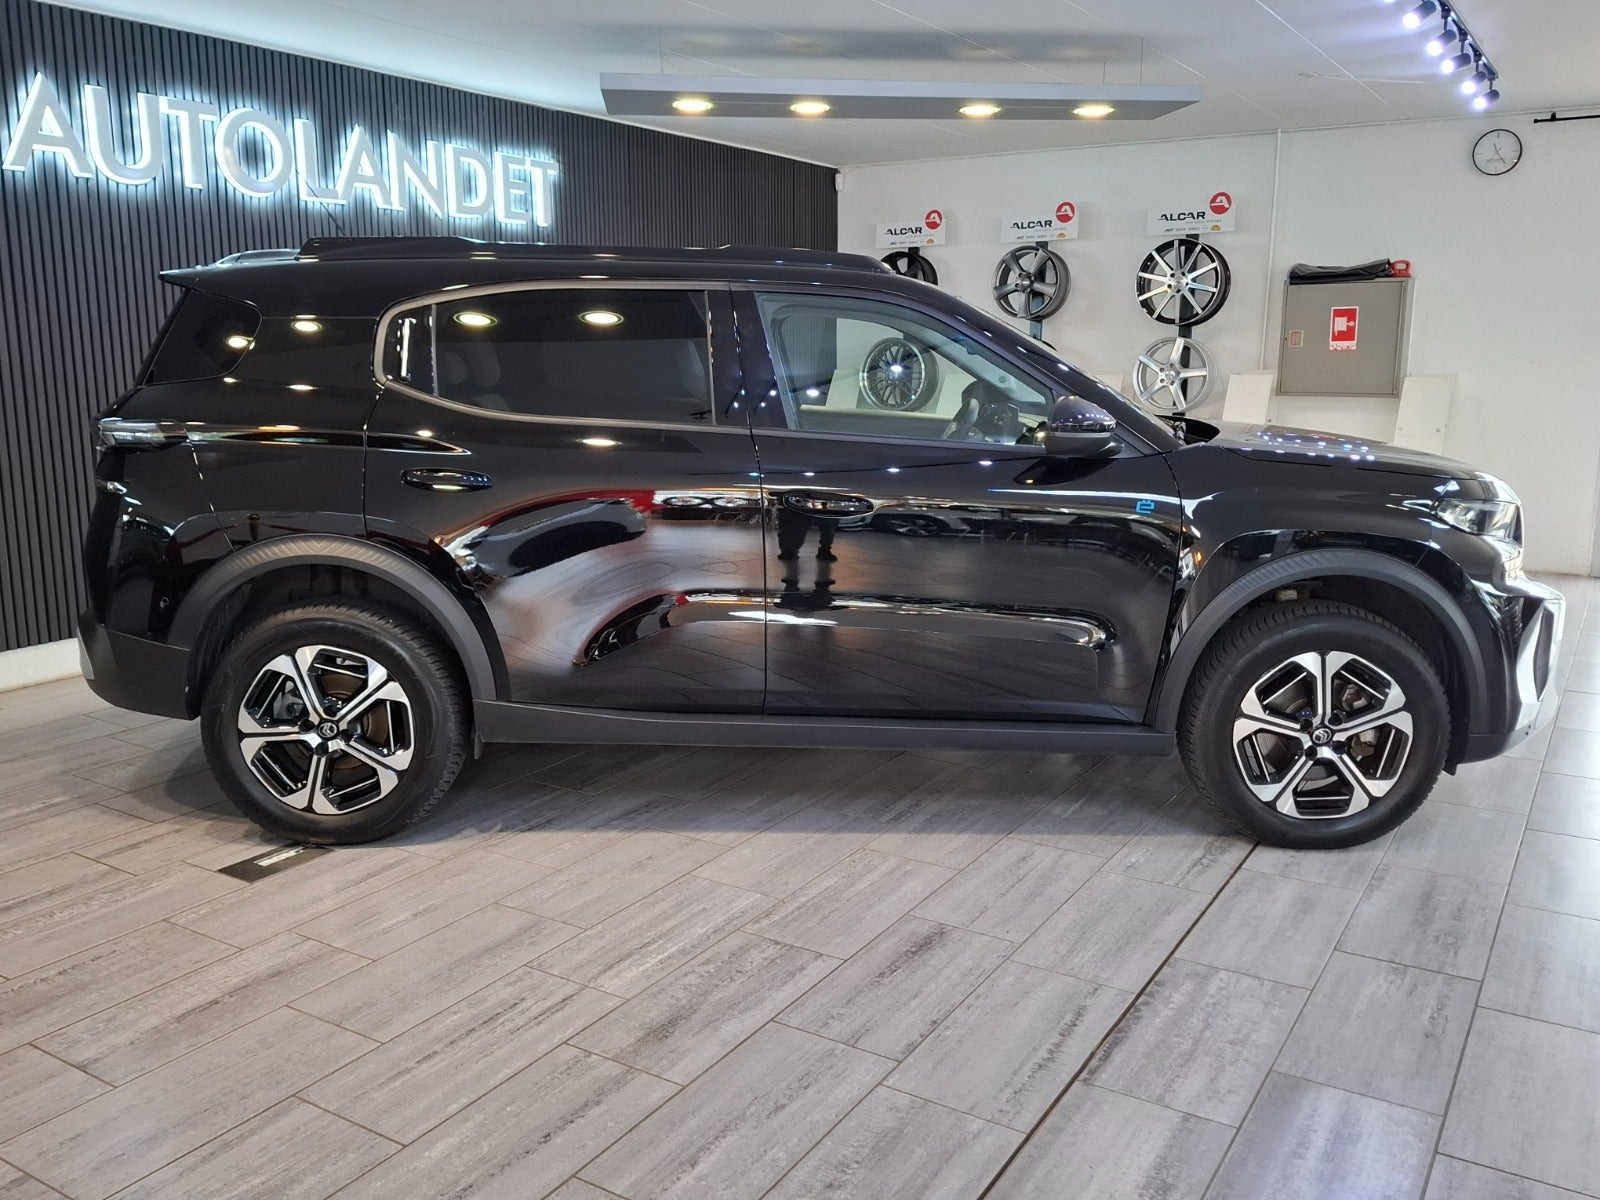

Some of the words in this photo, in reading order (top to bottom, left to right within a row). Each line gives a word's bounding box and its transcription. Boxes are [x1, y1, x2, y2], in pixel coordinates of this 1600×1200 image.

[2, 71, 560, 227] AUTOLANDET
[1157, 211, 1206, 222] ALCAR
[1009, 219, 1053, 230] ALCAR
[884, 226, 922, 236] ALCAR
